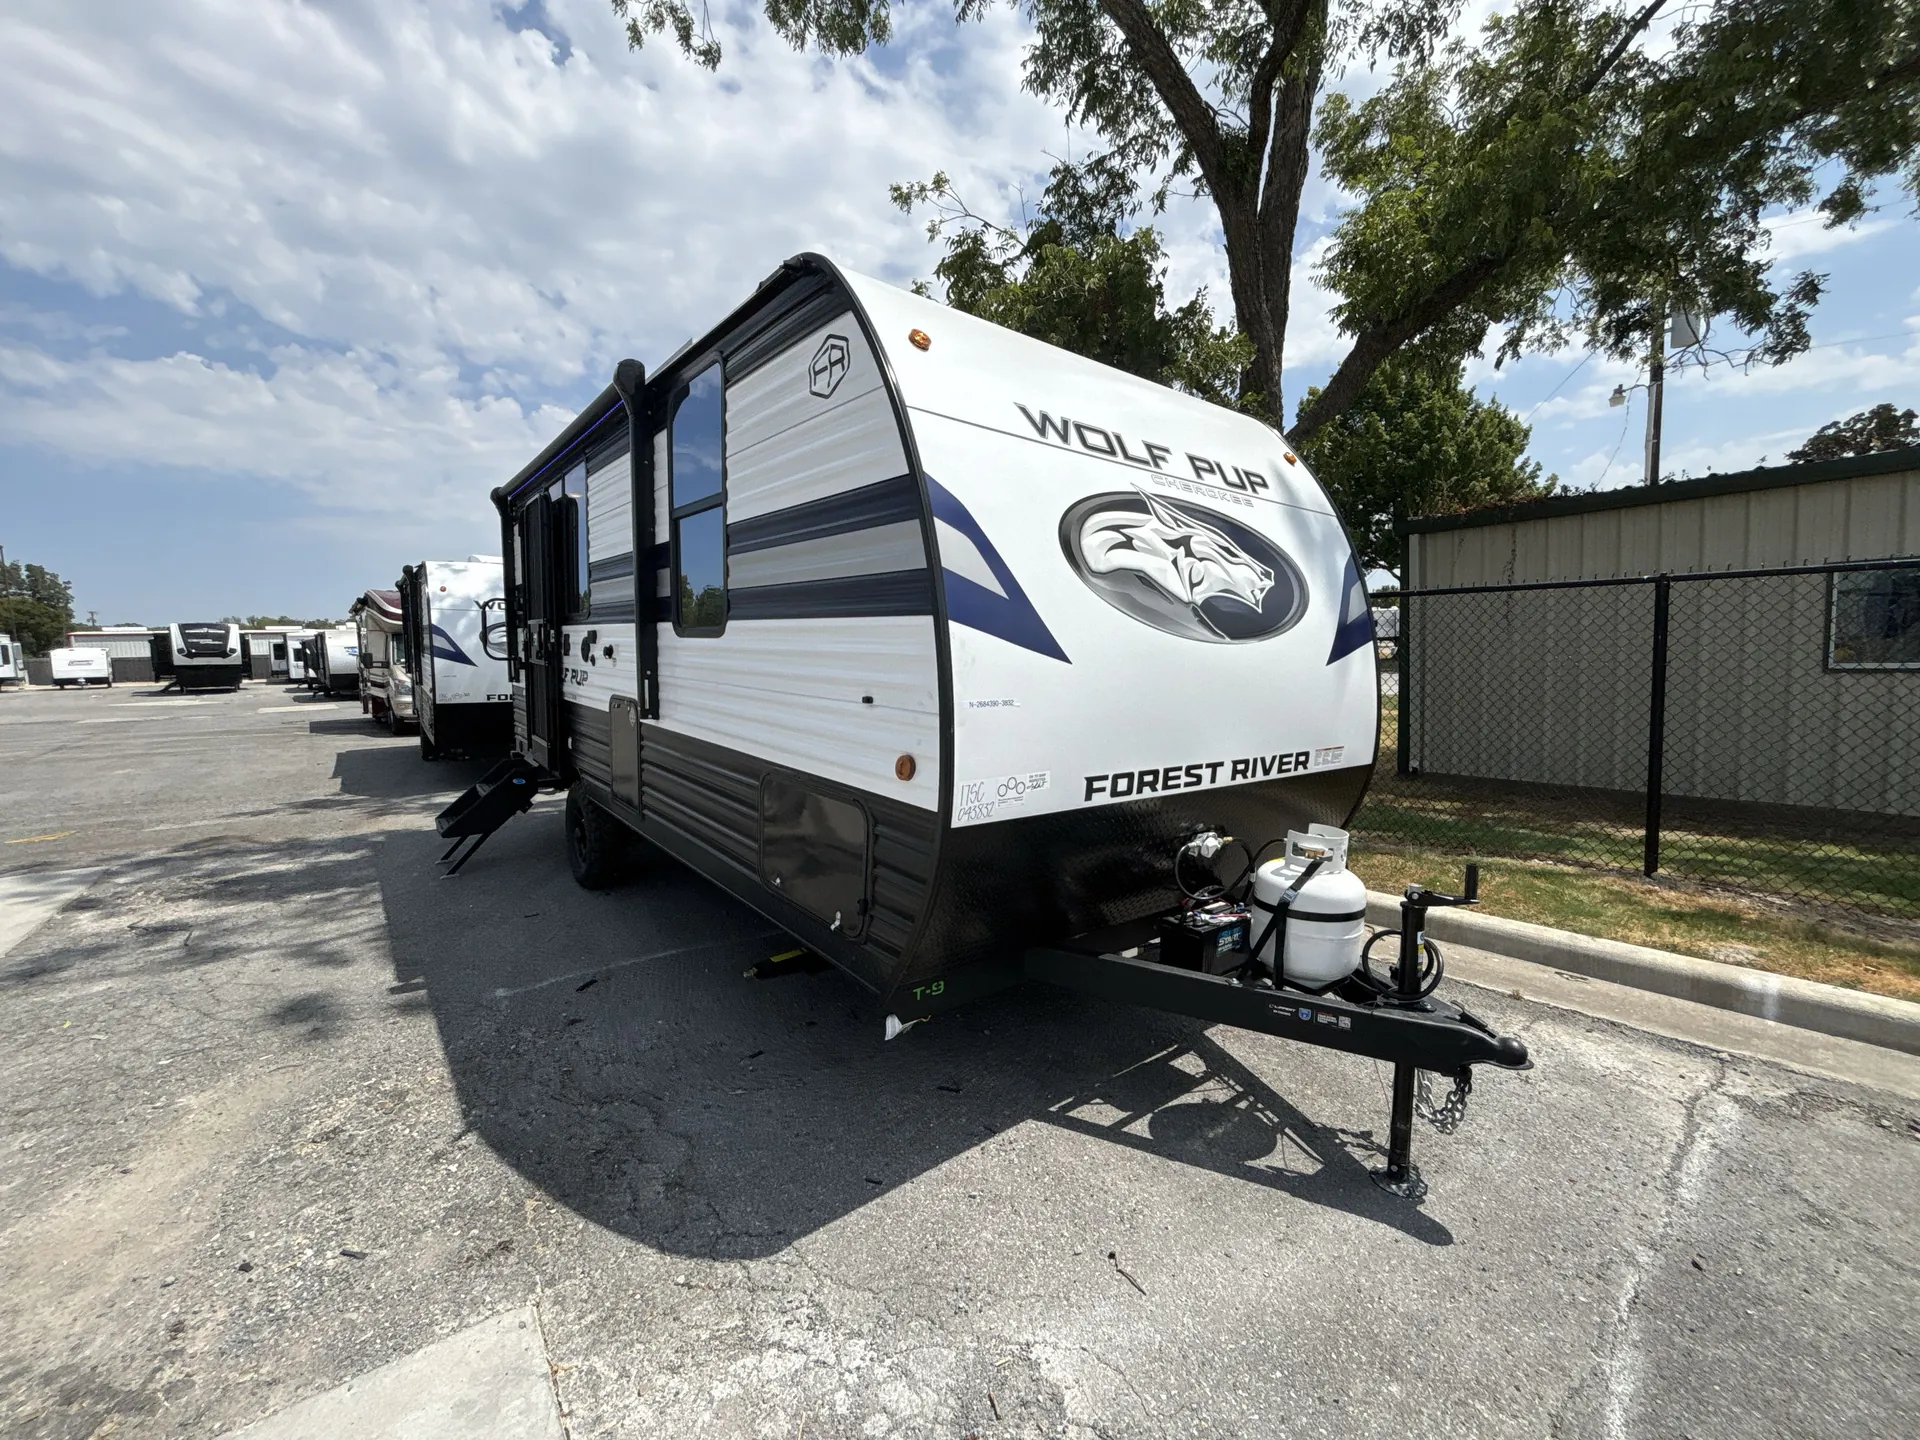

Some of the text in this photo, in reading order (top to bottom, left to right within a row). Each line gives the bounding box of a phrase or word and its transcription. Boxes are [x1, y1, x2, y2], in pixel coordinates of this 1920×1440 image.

[1013, 401, 1269, 495] WOLF PUP
[1150, 474, 1255, 508] CHEROKEE
[1084, 761, 1225, 802] FOREST
[1230, 750, 1311, 782] RIVER
